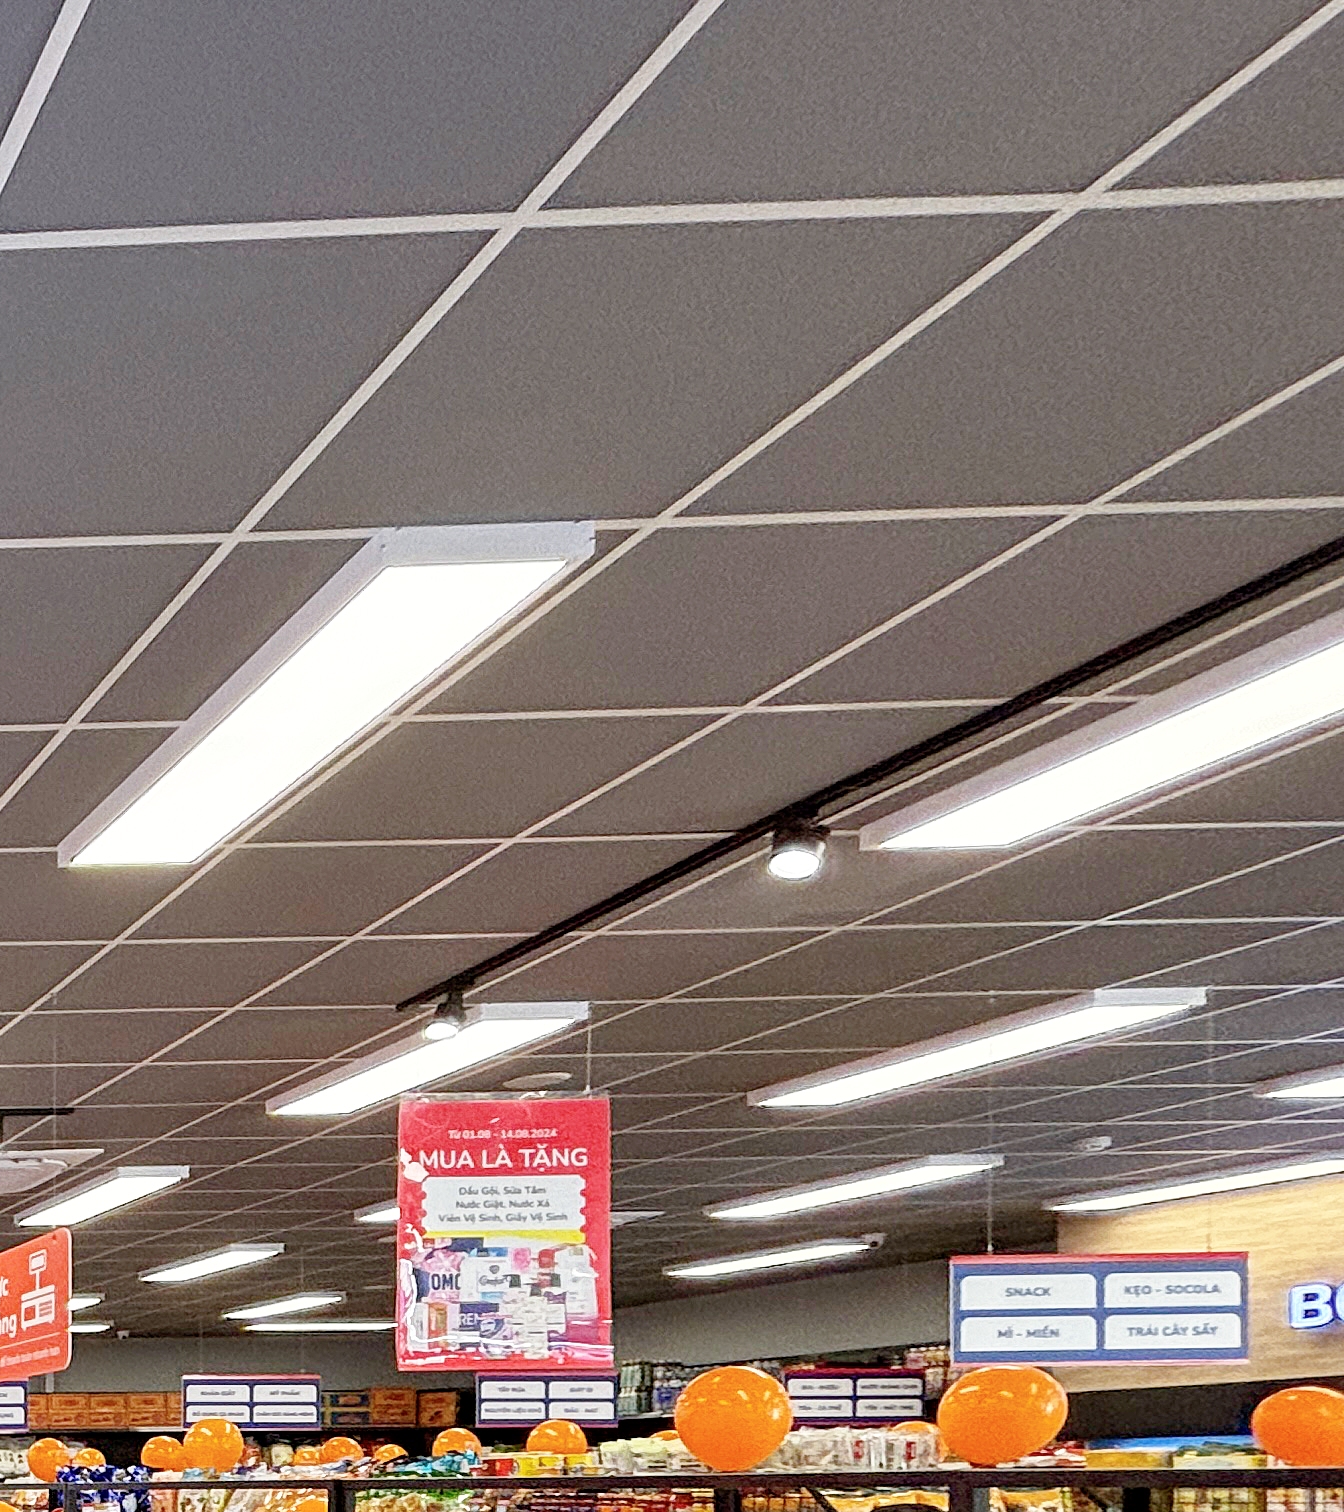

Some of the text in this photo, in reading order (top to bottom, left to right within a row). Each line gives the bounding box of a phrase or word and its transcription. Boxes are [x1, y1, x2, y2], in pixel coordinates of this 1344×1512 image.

[418, 1143, 589, 1173] MUA LÀ TẶNG
